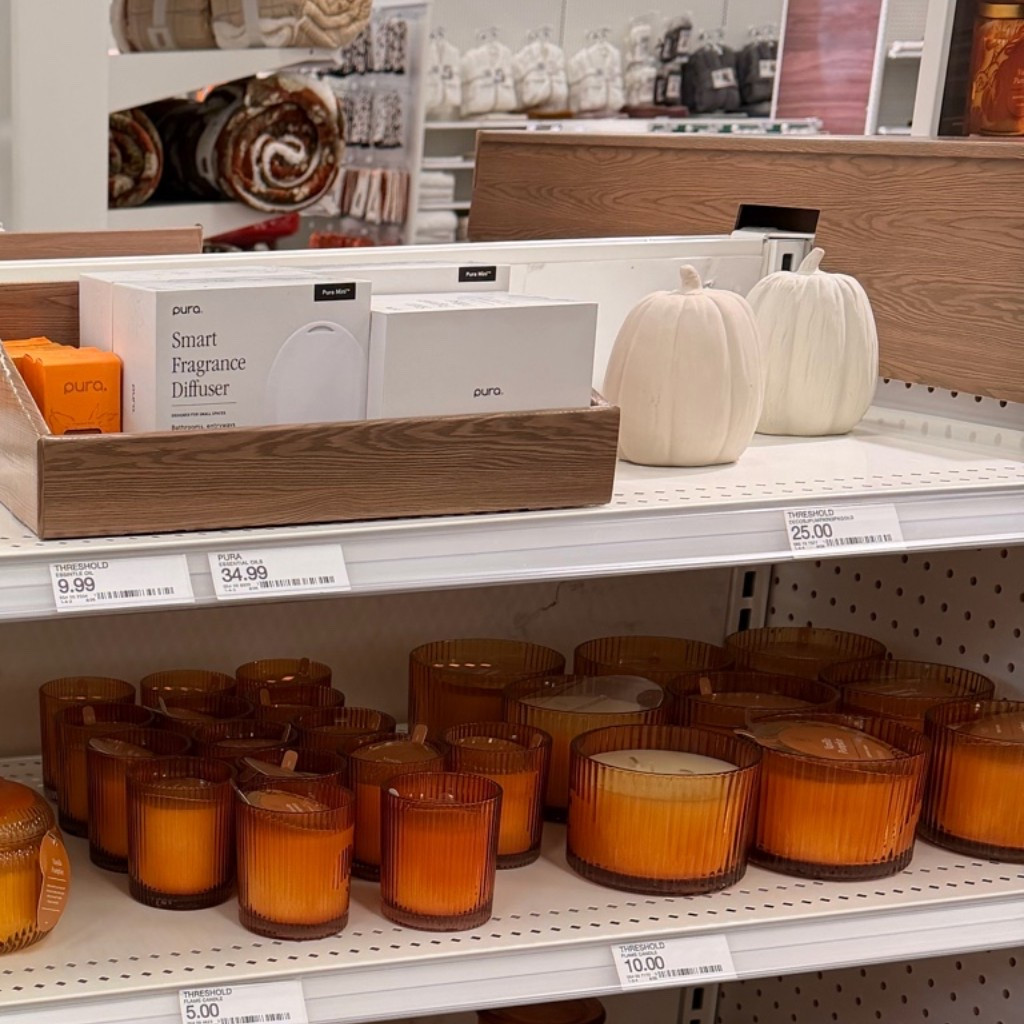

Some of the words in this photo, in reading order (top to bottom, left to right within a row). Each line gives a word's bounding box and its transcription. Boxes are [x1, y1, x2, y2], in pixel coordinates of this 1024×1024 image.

[172, 331, 217, 348] Smart
[172, 356, 246, 376] Fragrance
[64, 380, 107, 395] pura.
[172, 380, 229, 398] Diffuser
[788, 509, 834, 518] THRESHOLD
[791, 523, 832, 540] 25.00
[217, 553, 242, 561] PURA
[56, 562, 108, 572] THRESHOLD
[221, 566, 268, 582] 34.99
[58, 577, 95, 593] 9.99
[619, 942, 665, 952] THRESHOLD
[624, 956, 665, 973] 10.00
[183, 988, 232, 998] THRESHOLD
[186, 1003, 219, 1019] 5.00
